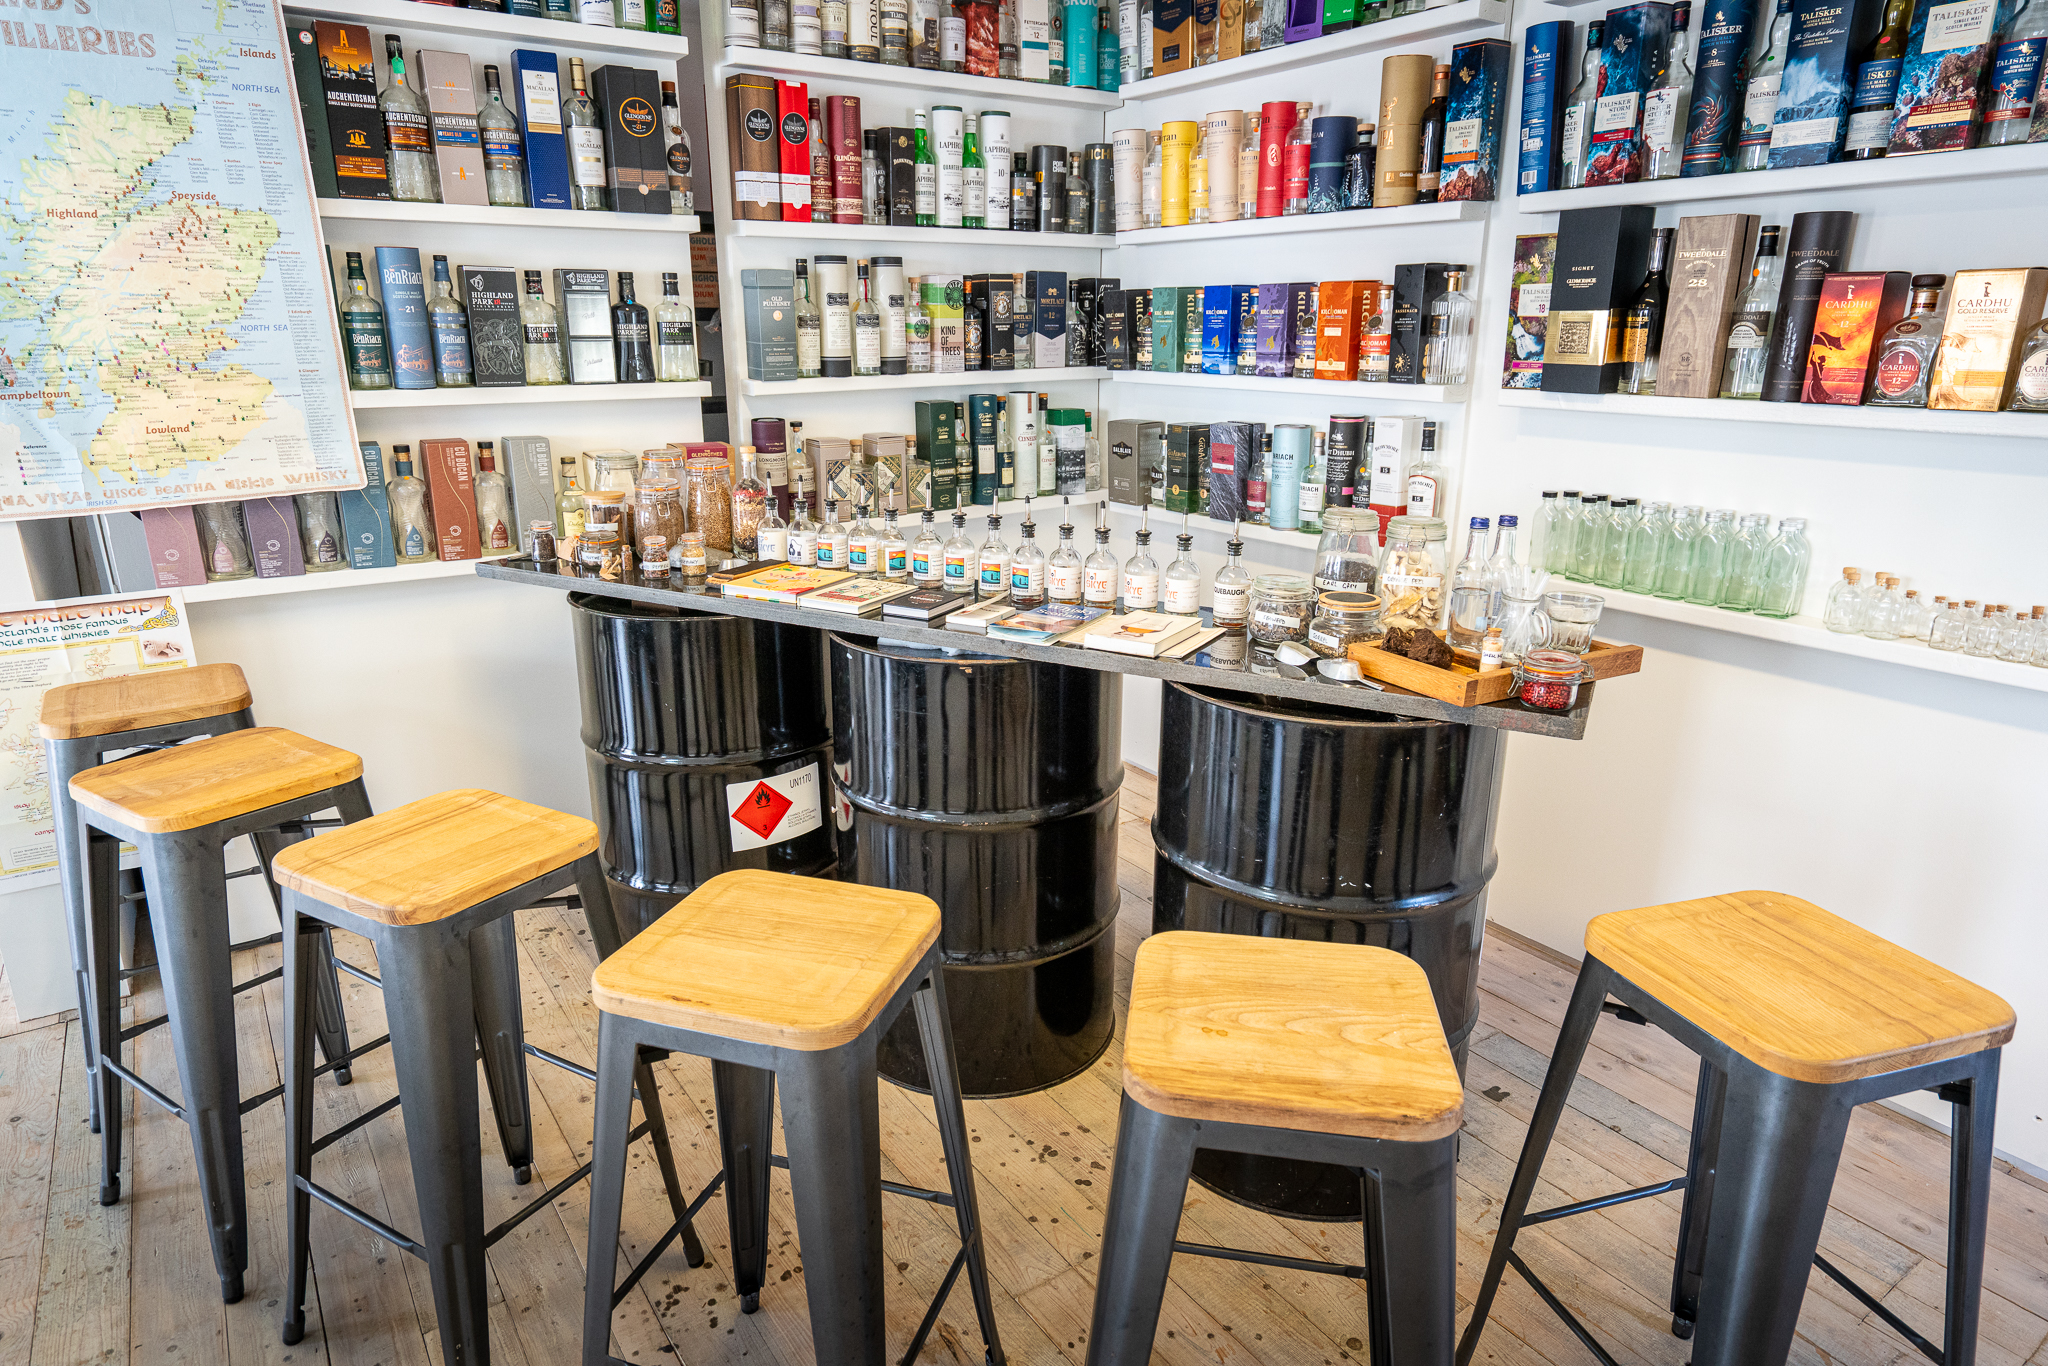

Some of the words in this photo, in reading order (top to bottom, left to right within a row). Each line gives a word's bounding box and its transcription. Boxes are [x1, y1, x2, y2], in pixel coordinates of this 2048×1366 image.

[662, 4, 674, 15] 125
[1800, 8, 1844, 21] TALISKER
[1932, 5, 1990, 21] TALISKER
[1701, 25, 1743, 40] TALISKER
[240, 48, 277, 60] Islands
[1711, 48, 1718, 56] 8
[1996, 56, 2040, 68] TALISKER
[232, 83, 262, 93] NORTH
[264, 86, 280, 94] SEA
[526, 84, 555, 92] MACALLAN
[328, 91, 376, 104] AUCHENTOSHAN
[1600, 98, 1632, 108] TALISKER
[1609, 104, 1632, 113] STORM
[386, 112, 428, 122] AUCHENTOSHAN
[435, 116, 477, 126] AUCHENTOSHAN
[624, 112, 652, 121] GLENGOYNE
[1449, 124, 1476, 132] TALISKER
[1380, 129, 1394, 146] IPA
[1462, 140, 1468, 148] 10
[998, 169, 1004, 177] 10
[171, 190, 217, 202] Speyside
[46, 208, 98, 220] Highland
[1678, 250, 1727, 260] TWEEDDALE
[1791, 250, 1840, 258] TWEEDDALE
[1794, 260, 1809, 269] GRAIN
[1816, 259, 1830, 268] TRUTH
[1688, 278, 1708, 287] 28
[1826, 300, 1872, 309] CARDHU
[1958, 298, 2012, 308] CARDHU
[1538, 304, 1546, 313] 18
[240, 324, 270, 332] NORTH
[273, 324, 288, 332] SEA
[940, 326, 956, 336] KING
[940, 338, 949, 346] OF
[941, 346, 960, 356] TREES
[1882, 364, 1918, 372] CARDHU
[146, 424, 190, 434] Lowland
[282, 470, 348, 485] WHISKY
[1086, 580, 1108, 590] SKYE
[790, 772, 812, 788] UN1170
